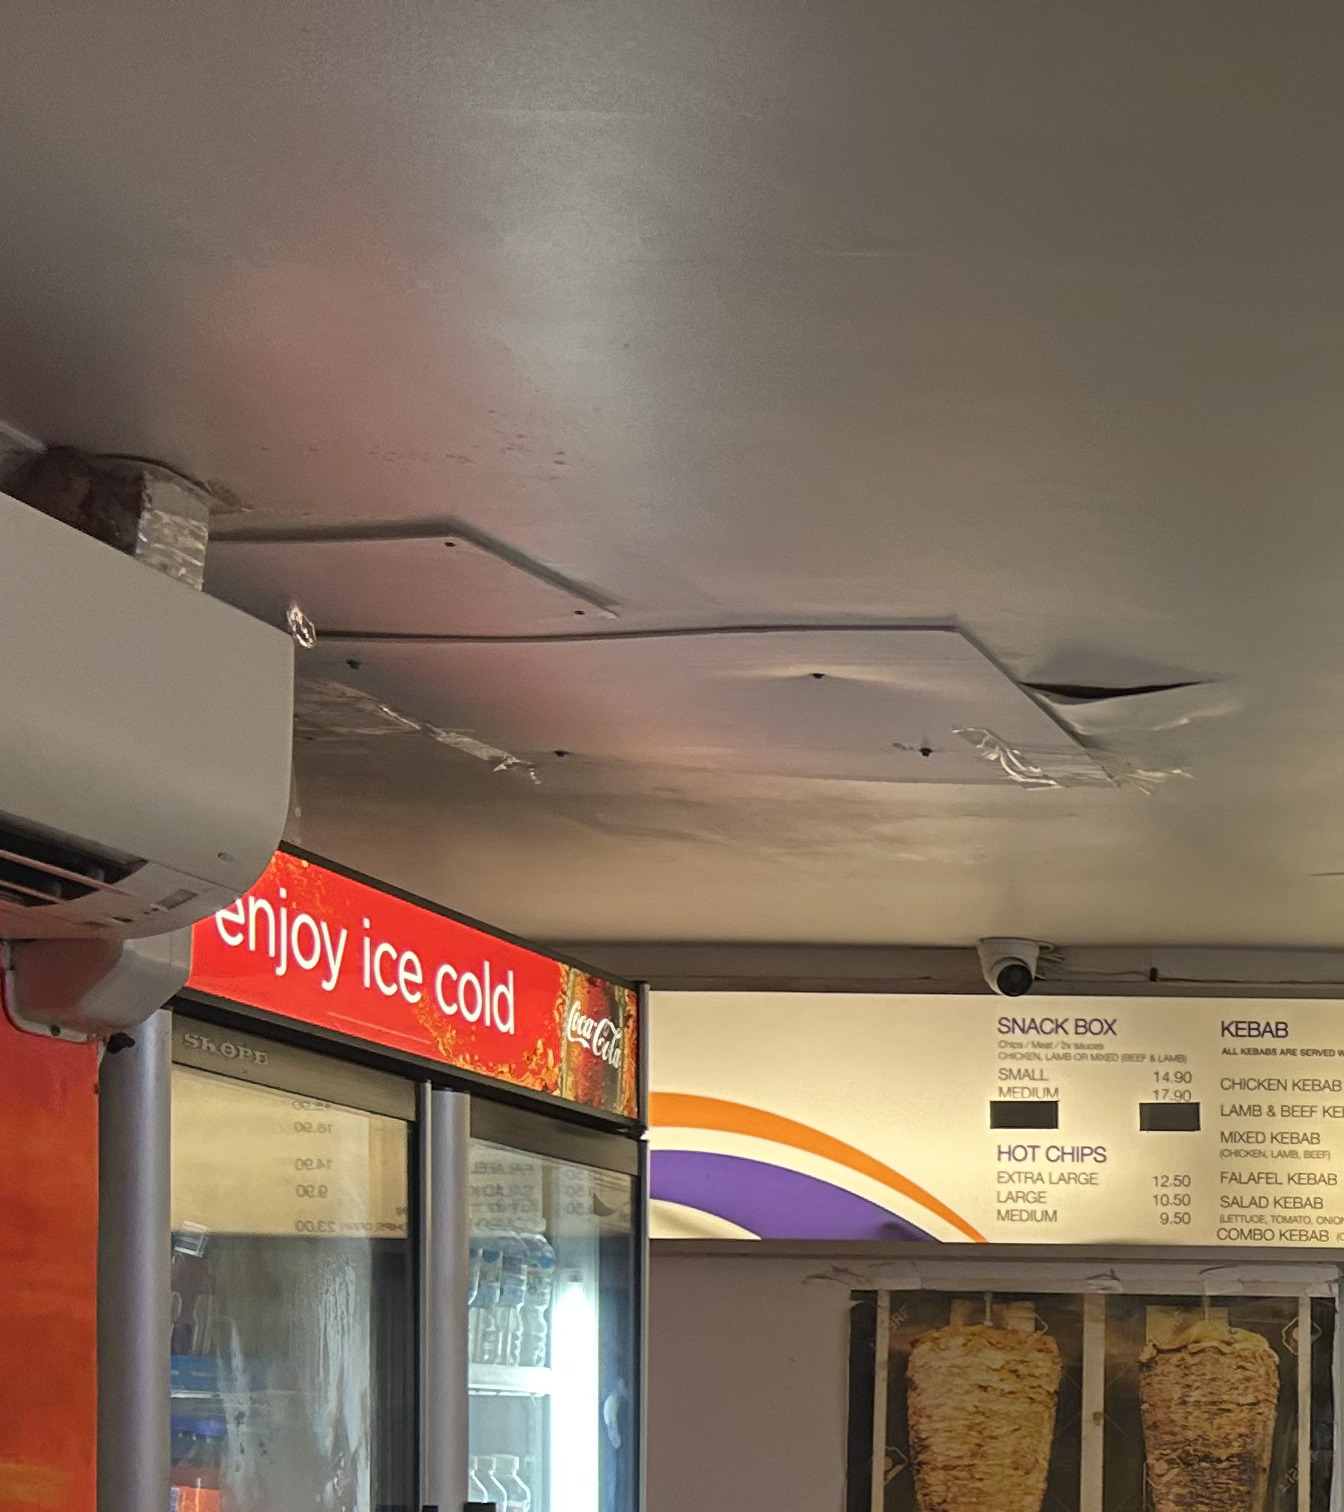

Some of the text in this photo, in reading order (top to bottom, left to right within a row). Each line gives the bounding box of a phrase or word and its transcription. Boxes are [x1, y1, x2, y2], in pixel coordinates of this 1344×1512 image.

[214, 887, 516, 1036] enjoy ice cold
[566, 999, 622, 1069] Coca-Cola
[997, 1017, 1118, 1036] SNACK BOX
[1221, 1020, 1289, 1038] KEBAB
[998, 1040, 1023, 1050] Chips
[1031, 1041, 1054, 1049] Meat
[1074, 1042, 1104, 1050] sauces
[1222, 1048, 1238, 1056] ALL
[1241, 1048, 1277, 1056] KEBABS
[1279, 1048, 1298, 1056] ARE
[1300, 1049, 1336, 1057] SERVED
[1045, 1052, 1071, 1061] LAMB
[1074, 1053, 1088, 1061] OR
[1090, 1053, 1119, 1062] MIXED
[998, 1068, 1192, 1083] SMALL 14.90
[1220, 1077, 1287, 1091] CHICKEN
[1292, 1079, 1342, 1092] KEBAB
[999, 1086, 1192, 1102] MEDIUM 17.90
[1220, 1104, 1263, 1117] LAMB
[1266, 1105, 1276, 1117] &
[1280, 1105, 1318, 1118] BEEF
[1220, 1131, 1266, 1145] MIXED
[1270, 1132, 1321, 1145] KEBAB
[997, 1144, 1107, 1163] HOT CHIPS
[1219, 1149, 1330, 1161] (CHICKEN, LAMB, BEEF)
[997, 1171, 1191, 1187] EXTRA LARGE 12.50
[1220, 1171, 1283, 1185] FALAFEL
[1287, 1172, 1338, 1185] KEBAB
[997, 1190, 1191, 1206] LARGE 10.50
[1220, 1195, 1269, 1209] SALAD
[1273, 1196, 1324, 1209] KEBAB
[997, 1209, 1191, 1225] MEDIUM 9.50
[1216, 1228, 1275, 1242] COMBO
[1279, 1229, 1330, 1242] KEBAB
